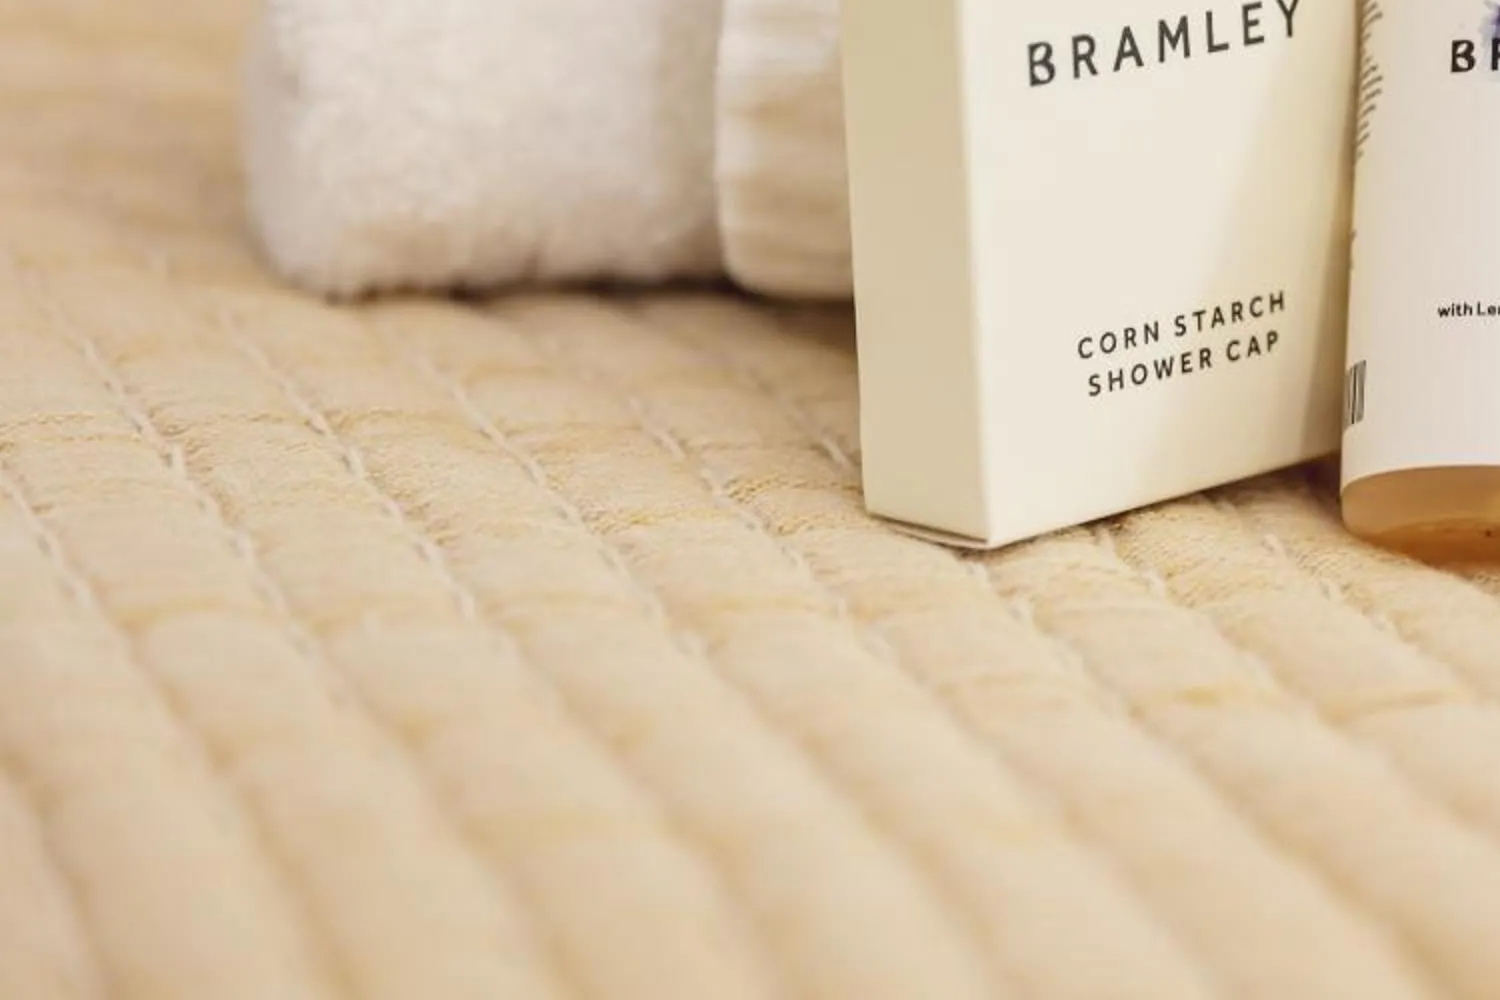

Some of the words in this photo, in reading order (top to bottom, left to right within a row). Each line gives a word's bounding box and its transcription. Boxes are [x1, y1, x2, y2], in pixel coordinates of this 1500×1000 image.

[1077, 320, 1159, 359] CORN
[1174, 291, 1285, 337] STARCH
[1437, 302, 1473, 318] with
[1088, 347, 1212, 397] SHOWER
[1225, 330, 1279, 362] CAP
